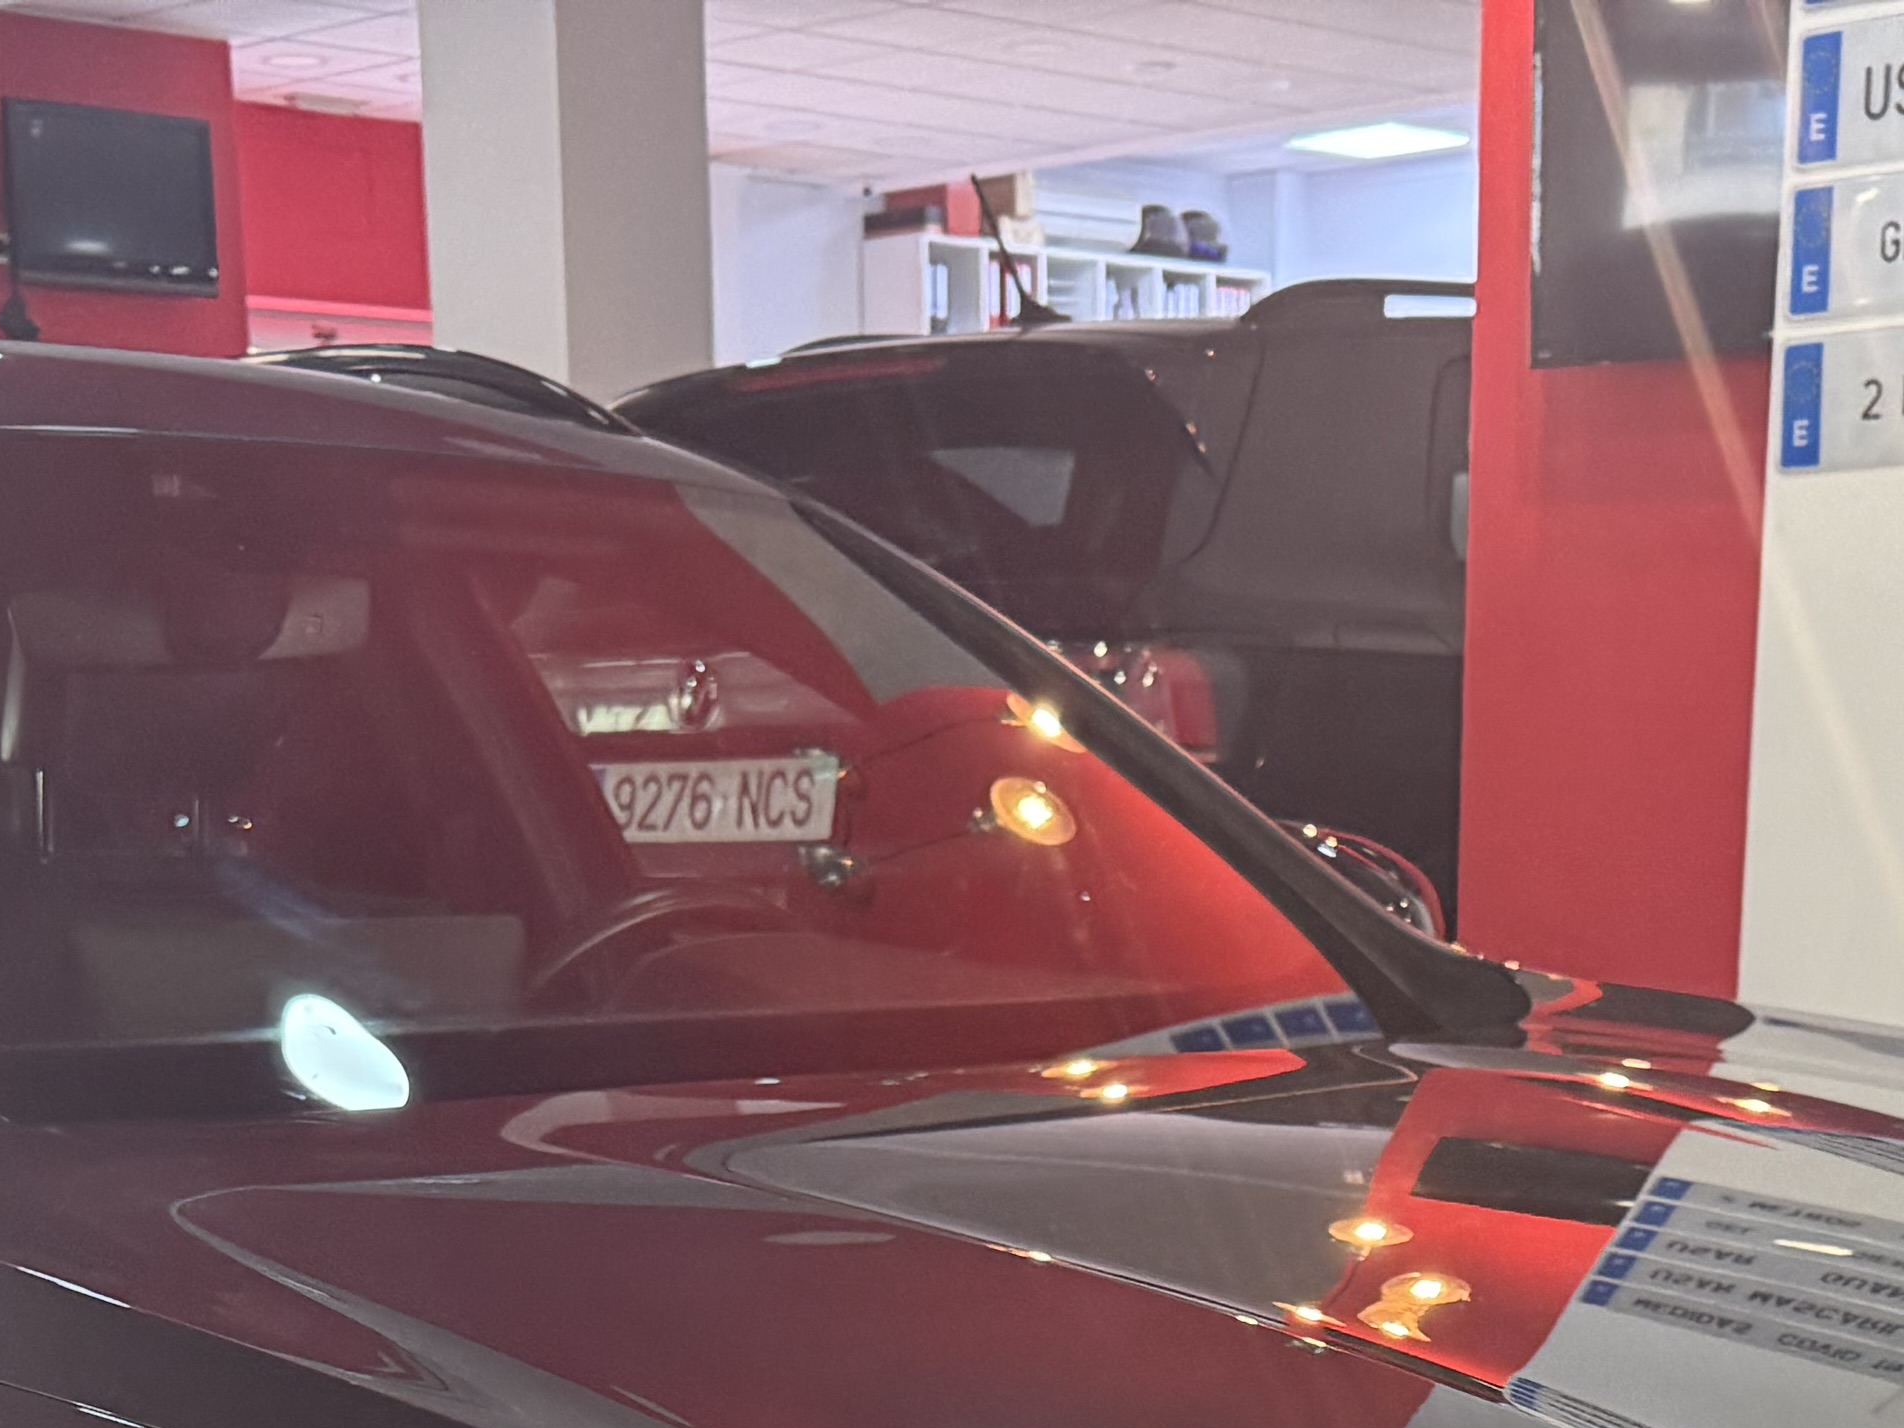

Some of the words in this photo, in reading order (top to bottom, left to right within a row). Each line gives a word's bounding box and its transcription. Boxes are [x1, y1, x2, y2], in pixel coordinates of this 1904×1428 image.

[1808, 113, 1827, 142] E
[1801, 265, 1819, 292] E
[1861, 378, 1883, 420] 2
[1793, 419, 1809, 446] E
[613, 772, 715, 833] 9276
[737, 770, 816, 831] NCS
